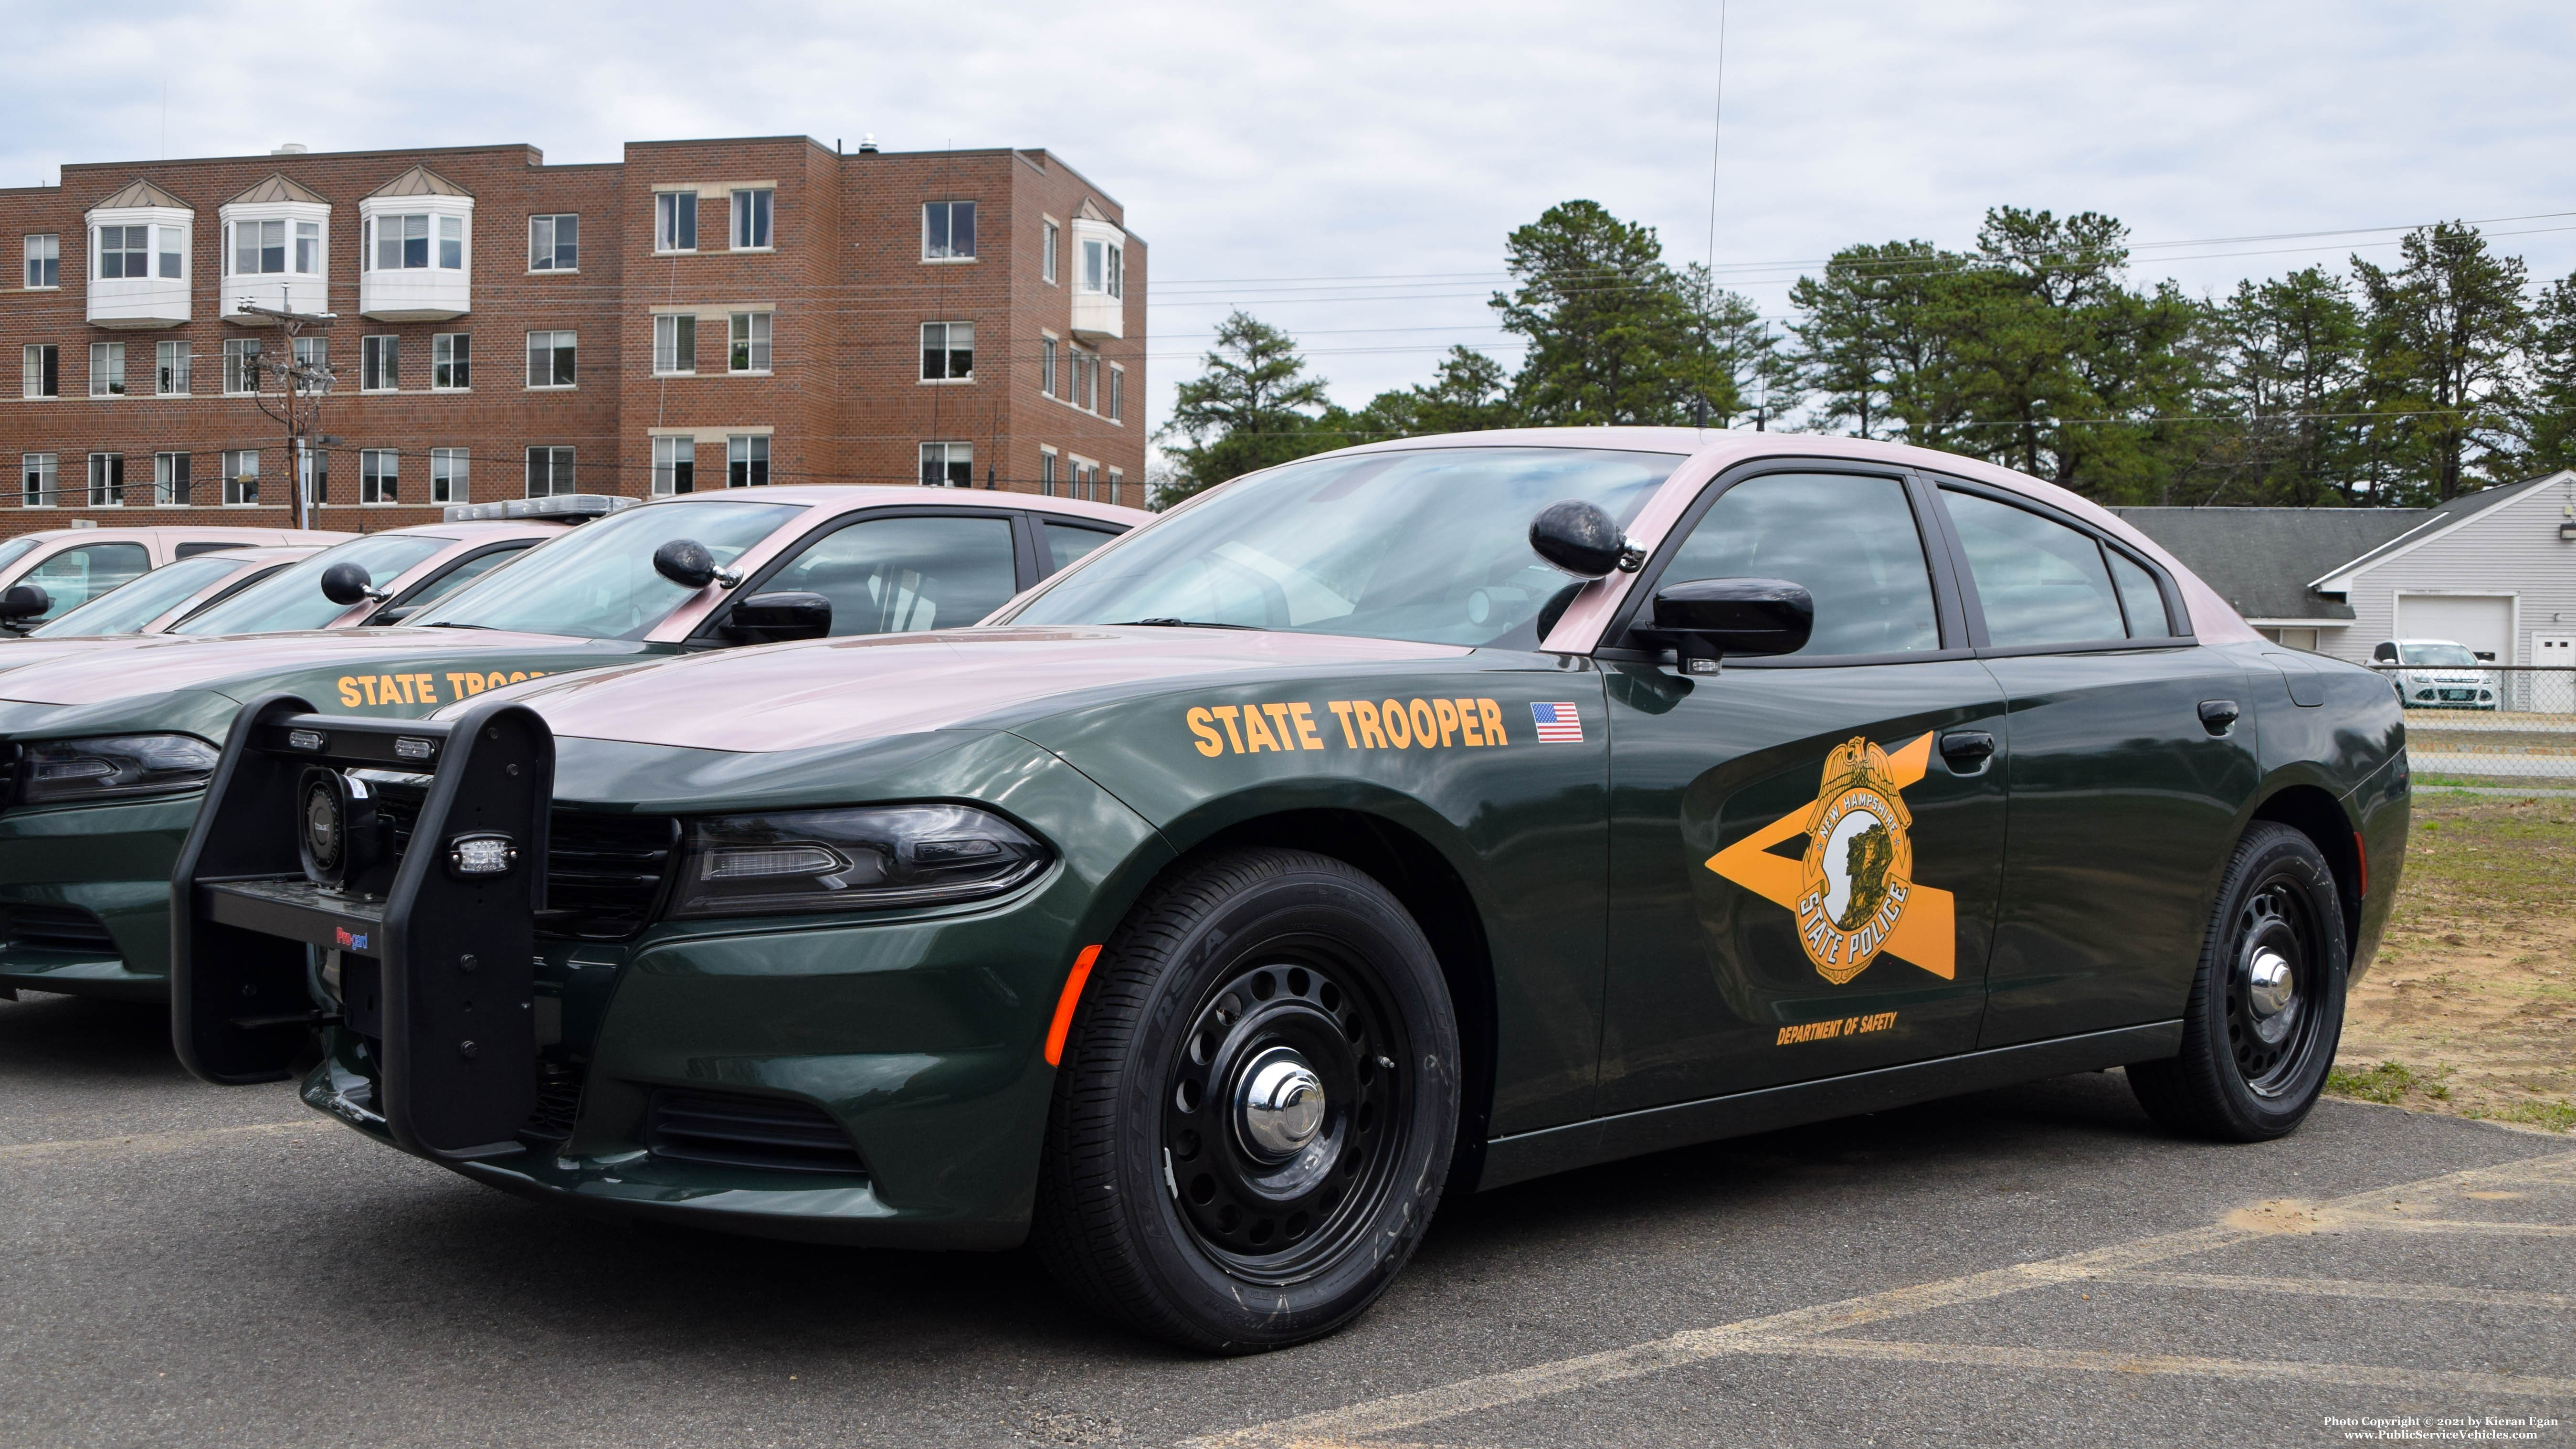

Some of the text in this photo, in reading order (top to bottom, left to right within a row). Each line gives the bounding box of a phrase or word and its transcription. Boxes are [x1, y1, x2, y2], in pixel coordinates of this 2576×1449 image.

[338, 673, 438, 707] STATE
[1186, 698, 1509, 758] STATE TROOPER
[1819, 793, 1898, 839] NEW HAMPSHIRE
[336, 926, 368, 951] Pro-gard
[1800, 880, 1909, 964] STATE POLICE
[1776, 1011, 1898, 1046] DEPARTMENT OF SAFETY
